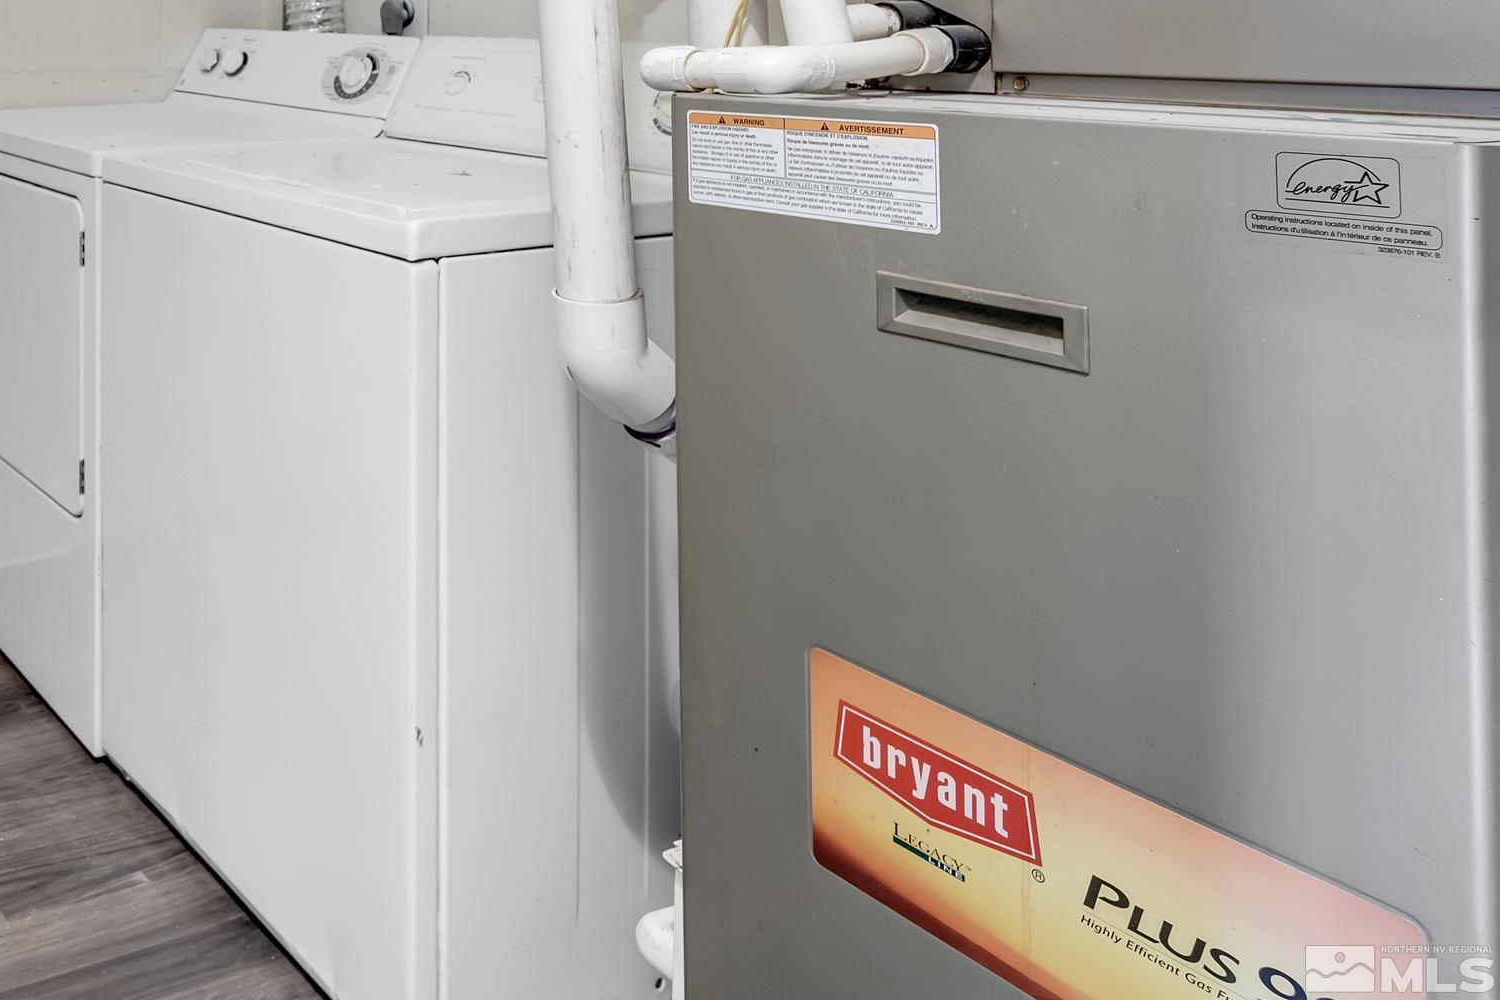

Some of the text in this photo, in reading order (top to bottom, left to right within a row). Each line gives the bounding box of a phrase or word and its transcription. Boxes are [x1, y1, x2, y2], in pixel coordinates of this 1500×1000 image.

[732, 118, 765, 126] WARNING
[838, 124, 905, 136] AVERTISSEMENT
[1286, 181, 1355, 203] energy
[1251, 213, 1283, 223] Operating
[1284, 216, 1323, 226] instructions
[1324, 220, 1350, 229] located
[1362, 224, 1384, 232] inside
[1251, 223, 1289, 232] Instructions
[1290, 226, 1329, 236] d'utilisation
[1336, 231, 1370, 240] l'intérieur
[1393, 237, 1428, 246] panneau.
[862, 725, 1009, 838] bryant
[928, 856, 965, 882] LINE
[1083, 874, 1240, 984] PLUS
[1081, 914, 1213, 994] Highly Efficient Gas
